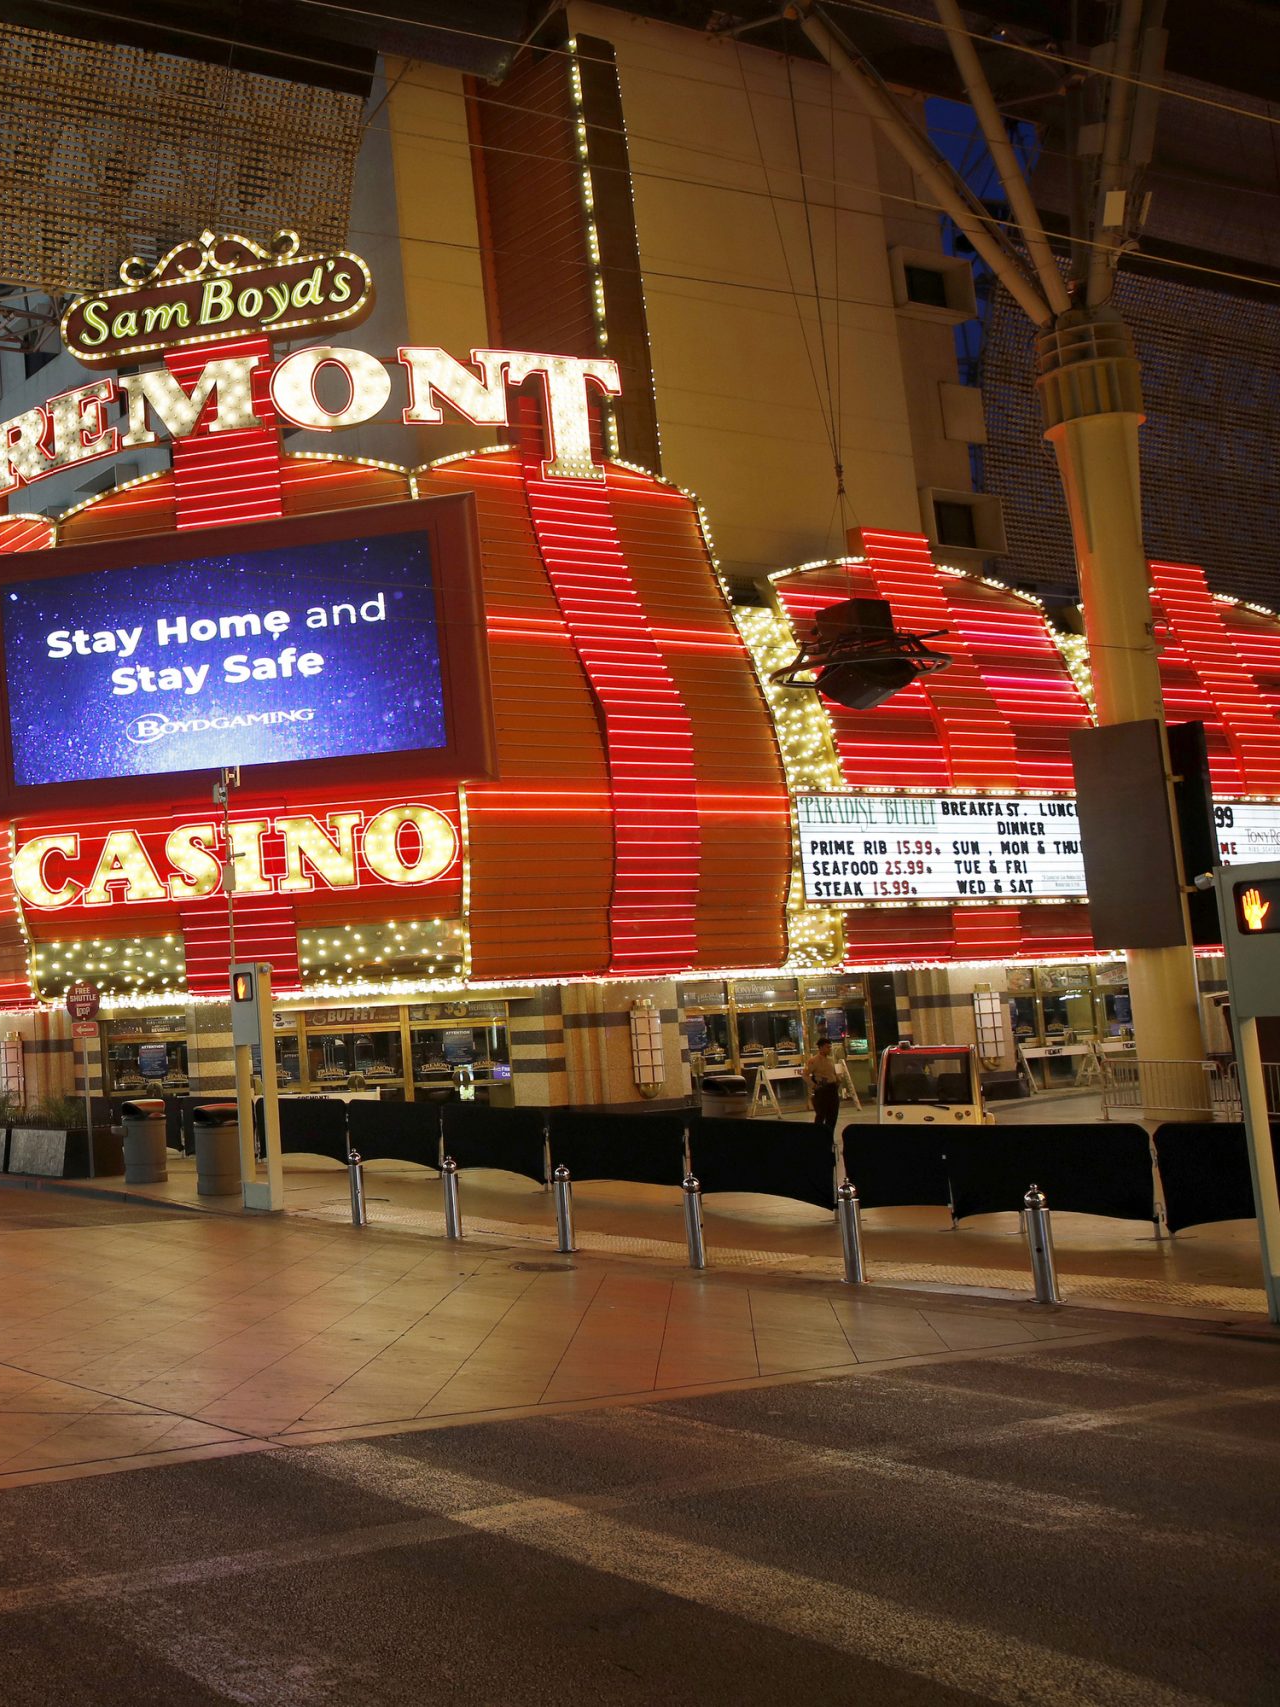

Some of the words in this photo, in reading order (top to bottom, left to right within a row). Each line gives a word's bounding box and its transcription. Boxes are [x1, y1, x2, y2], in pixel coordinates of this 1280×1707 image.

[79, 301, 190, 347] Sam
[198, 259, 353, 326] Boyd's
[46, 624, 144, 660] Stay
[156, 610, 291, 648] Home
[305, 592, 387, 630] and
[111, 660, 210, 696] Stay
[222, 647, 326, 684] Safe
[800, 797, 877, 832] PARADISE
[881, 799, 936, 825] BUFFET
[997, 821, 1045, 836] DINNER
[810, 840, 855, 855] PRIME
[863, 840, 887, 855] RIB
[1000, 841, 1029, 855] MON
[1037, 840, 1046, 854] &
[13, 803, 459, 911] CASINO
[812, 860, 879, 876] SEAFOOD
[954, 859, 982, 874] TUE
[989, 859, 998, 874] &
[1005, 860, 1028, 874] FRI
[814, 881, 863, 897] STEAK
[956, 879, 987, 894] WED
[993, 879, 1003, 893] &
[1009, 879, 1034, 893] SAT
[69, 993, 97, 1003] SHUTTLE
[75, 987, 91, 995] FREE
[327, 1007, 377, 1023] BUFFET
